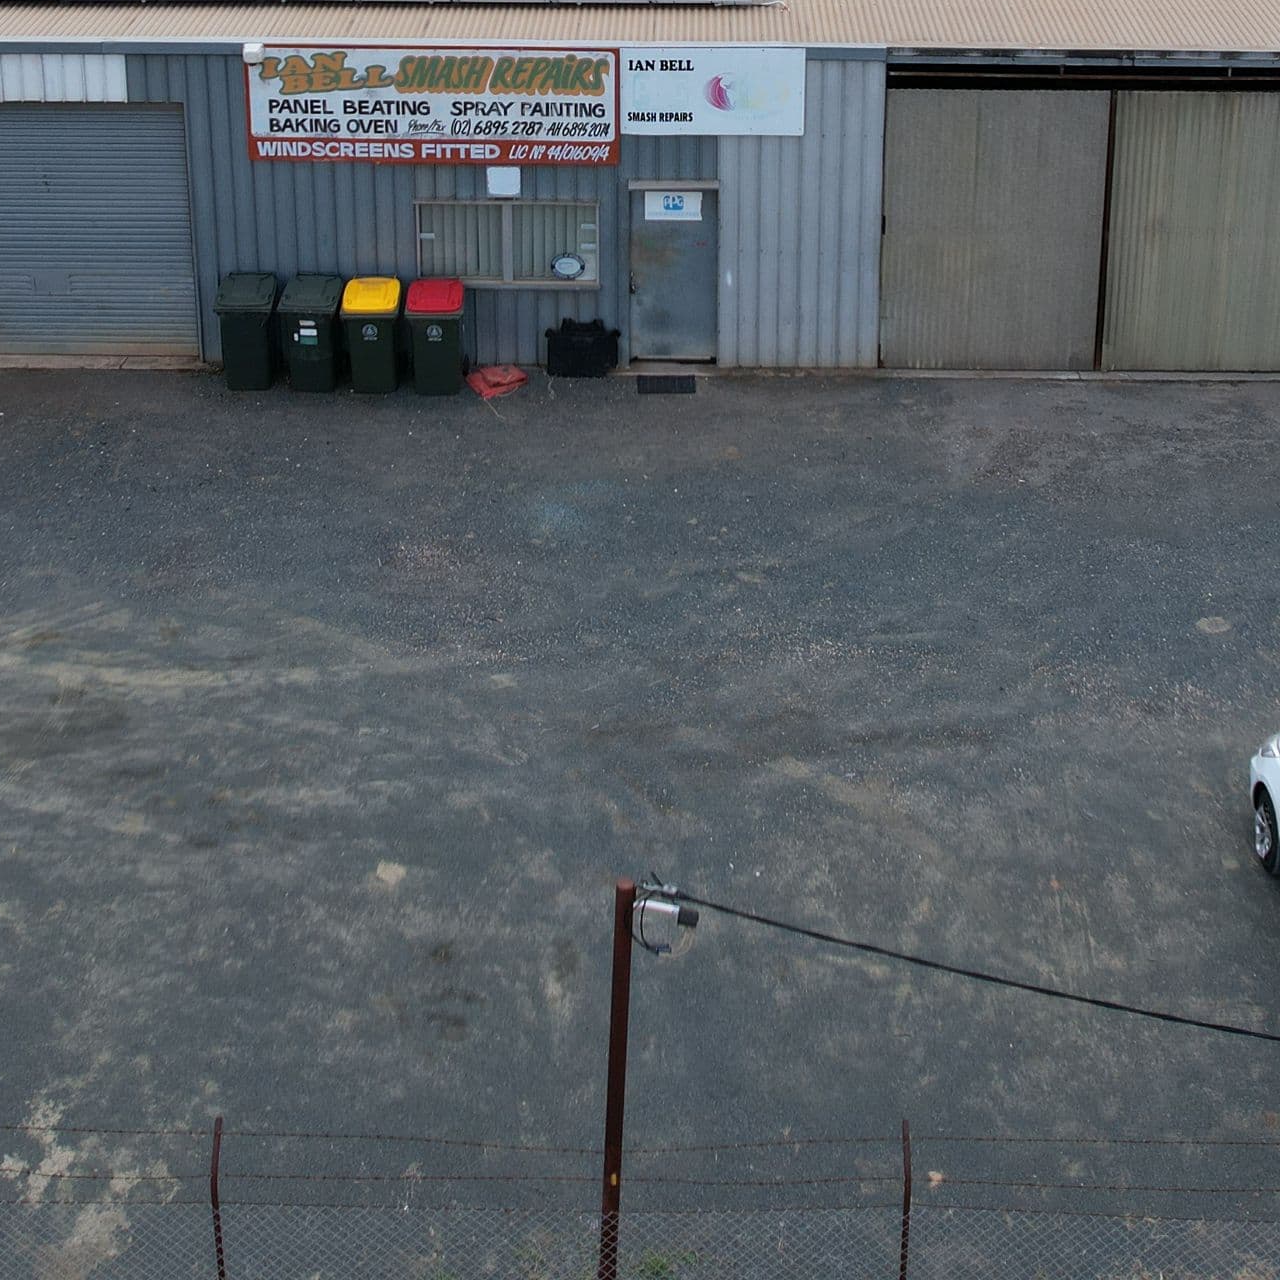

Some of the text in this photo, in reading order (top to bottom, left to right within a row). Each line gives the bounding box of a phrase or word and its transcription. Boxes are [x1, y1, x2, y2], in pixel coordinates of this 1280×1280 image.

[259, 51, 348, 80] IAN
[394, 55, 494, 94] SMASH
[628, 59, 695, 72] IAN BELL
[279, 66, 395, 95] BELL
[268, 99, 606, 118] PANEL BEATING SPRAY PAINTING
[627, 111, 694, 123] SMASH REPAIRS
[270, 117, 341, 134] BAKING
[346, 118, 398, 134] OVEN
[450, 118, 472, 136] (02)
[473, 120, 509, 136] 6895
[511, 120, 543, 136] 2787
[256, 141, 414, 158] WINDSCREENS
[421, 143, 501, 159] FITTED
